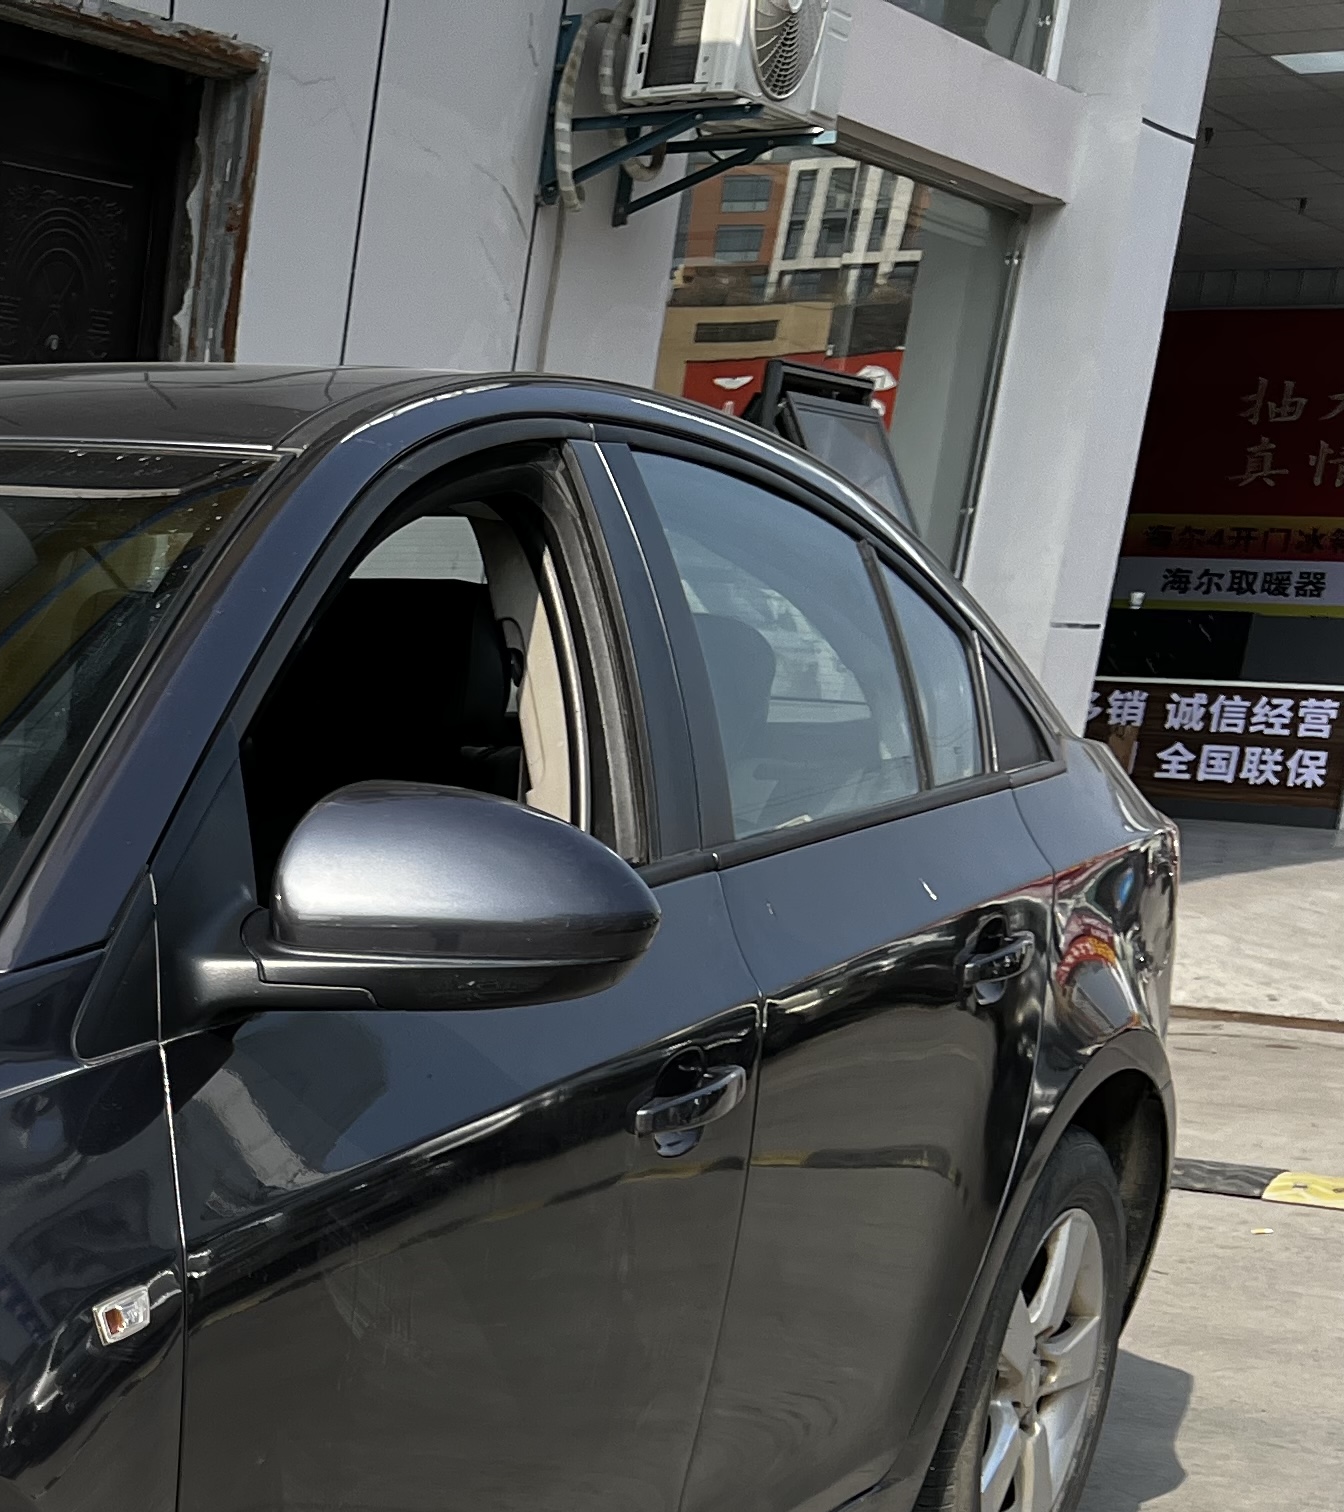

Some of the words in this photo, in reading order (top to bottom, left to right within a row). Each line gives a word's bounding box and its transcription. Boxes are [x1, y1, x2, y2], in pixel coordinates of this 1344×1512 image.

[1161, 567, 1327, 598] 海尔取暖器
[1164, 692, 1341, 740] 诚信经营
[1153, 741, 1329, 789] 全国联保
